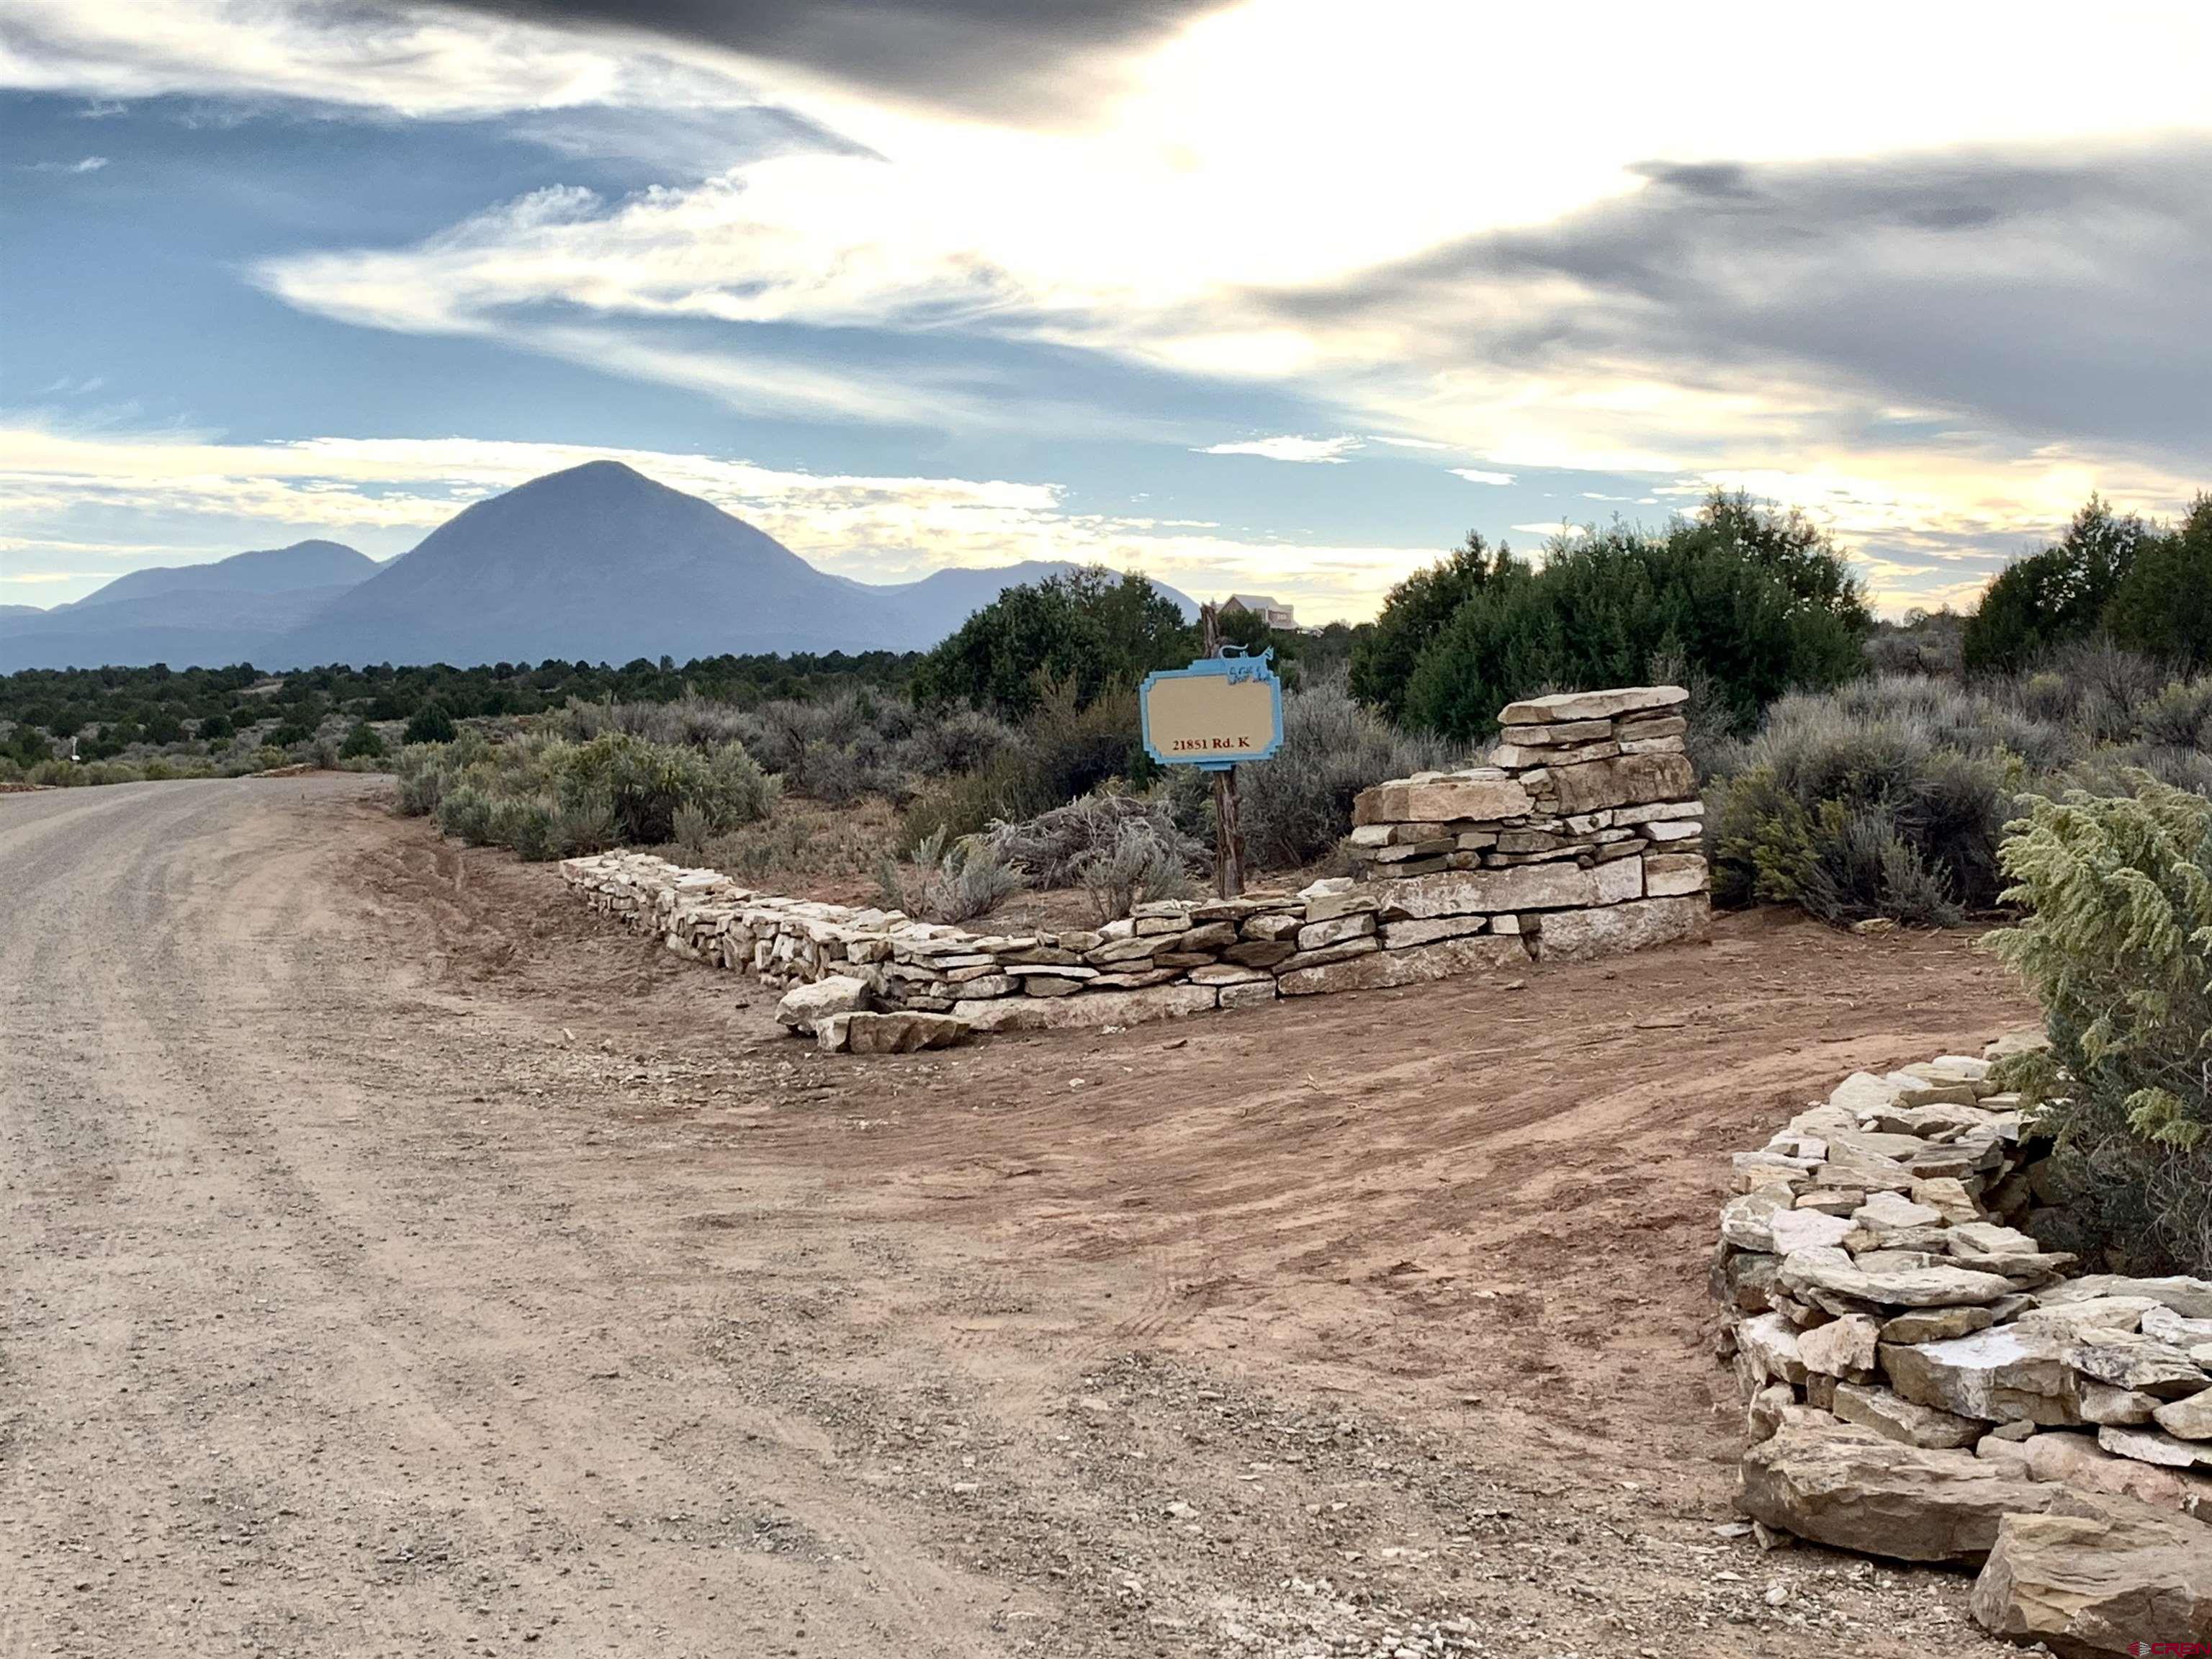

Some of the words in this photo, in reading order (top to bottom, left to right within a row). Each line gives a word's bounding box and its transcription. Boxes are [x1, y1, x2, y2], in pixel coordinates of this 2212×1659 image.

[1173, 739, 1208, 750] 21851
[1213, 737, 1234, 749] Rd.
[1238, 737, 1251, 747] K
